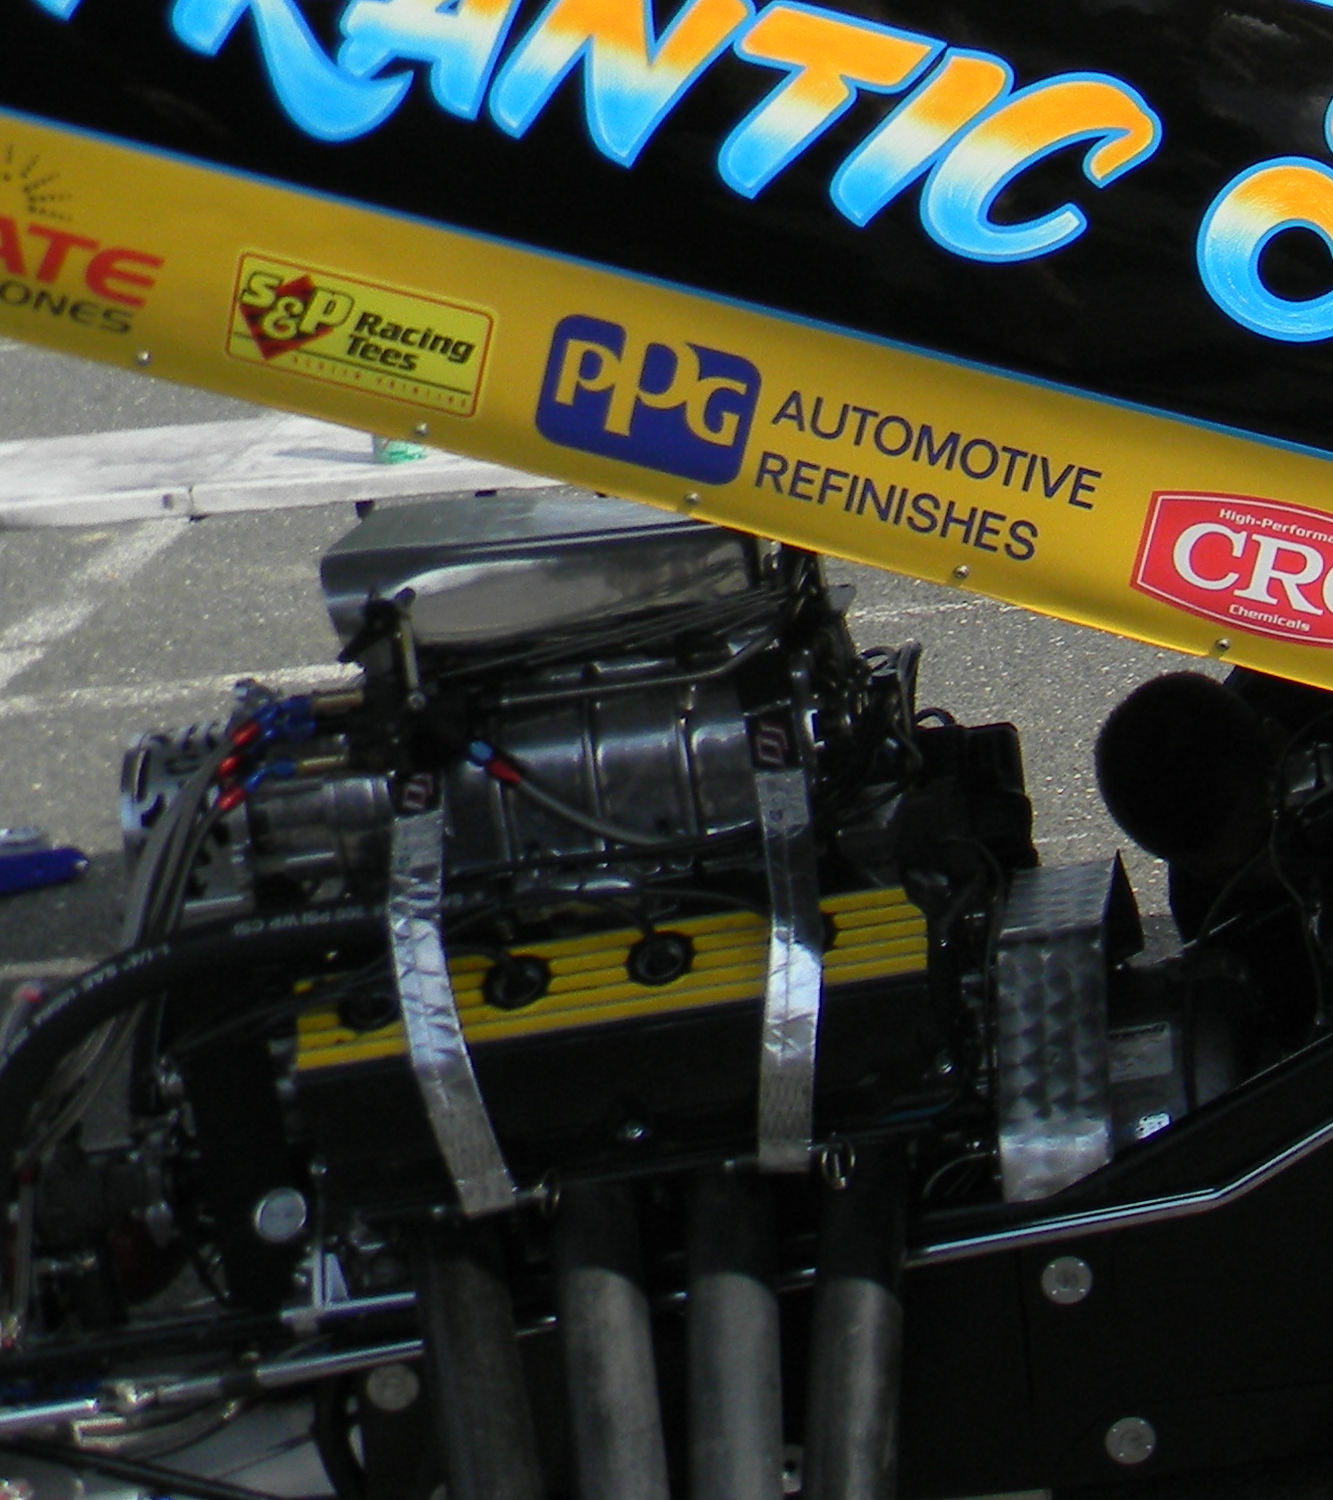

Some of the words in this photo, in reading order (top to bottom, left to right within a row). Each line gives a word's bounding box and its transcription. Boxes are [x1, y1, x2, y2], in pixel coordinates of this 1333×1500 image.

[240, 270, 355, 341] S&P
[353, 311, 477, 365] Racing
[346, 333, 420, 372] Tees
[553, 337, 750, 448] PPG
[771, 389, 1103, 511] AUTOMOTIVE
[754, 450, 1039, 562] REFINISHES
[1228, 602, 1311, 633] Chemicals
